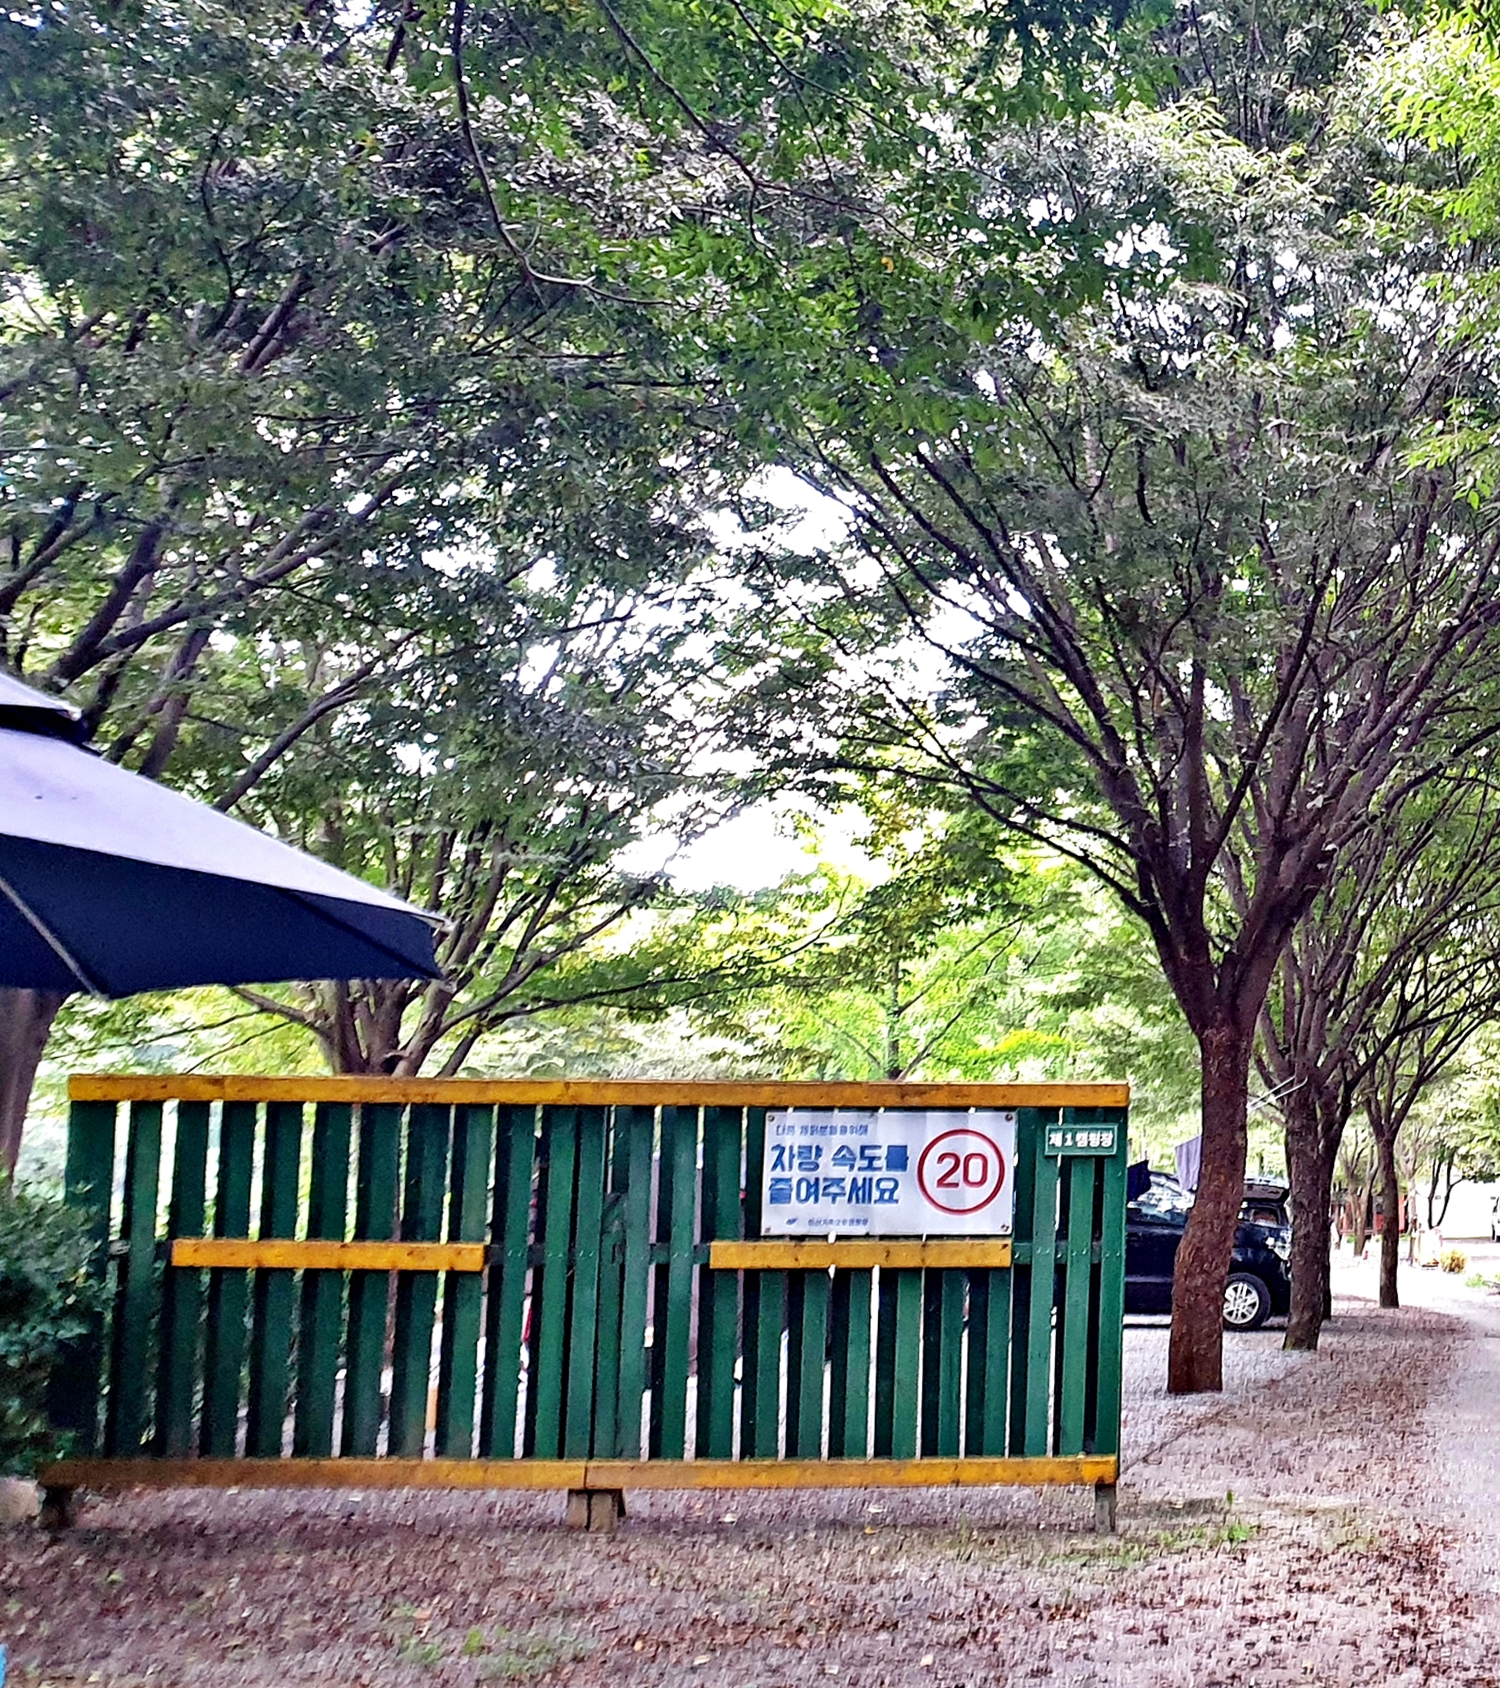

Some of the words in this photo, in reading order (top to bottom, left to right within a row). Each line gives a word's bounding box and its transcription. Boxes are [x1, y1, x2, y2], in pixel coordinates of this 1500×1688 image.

[770, 1144, 823, 1172] 차량
[831, 1144, 910, 1172] 속도를
[936, 1152, 989, 1188] 20
[768, 1177, 900, 1205] 줄여주세요
